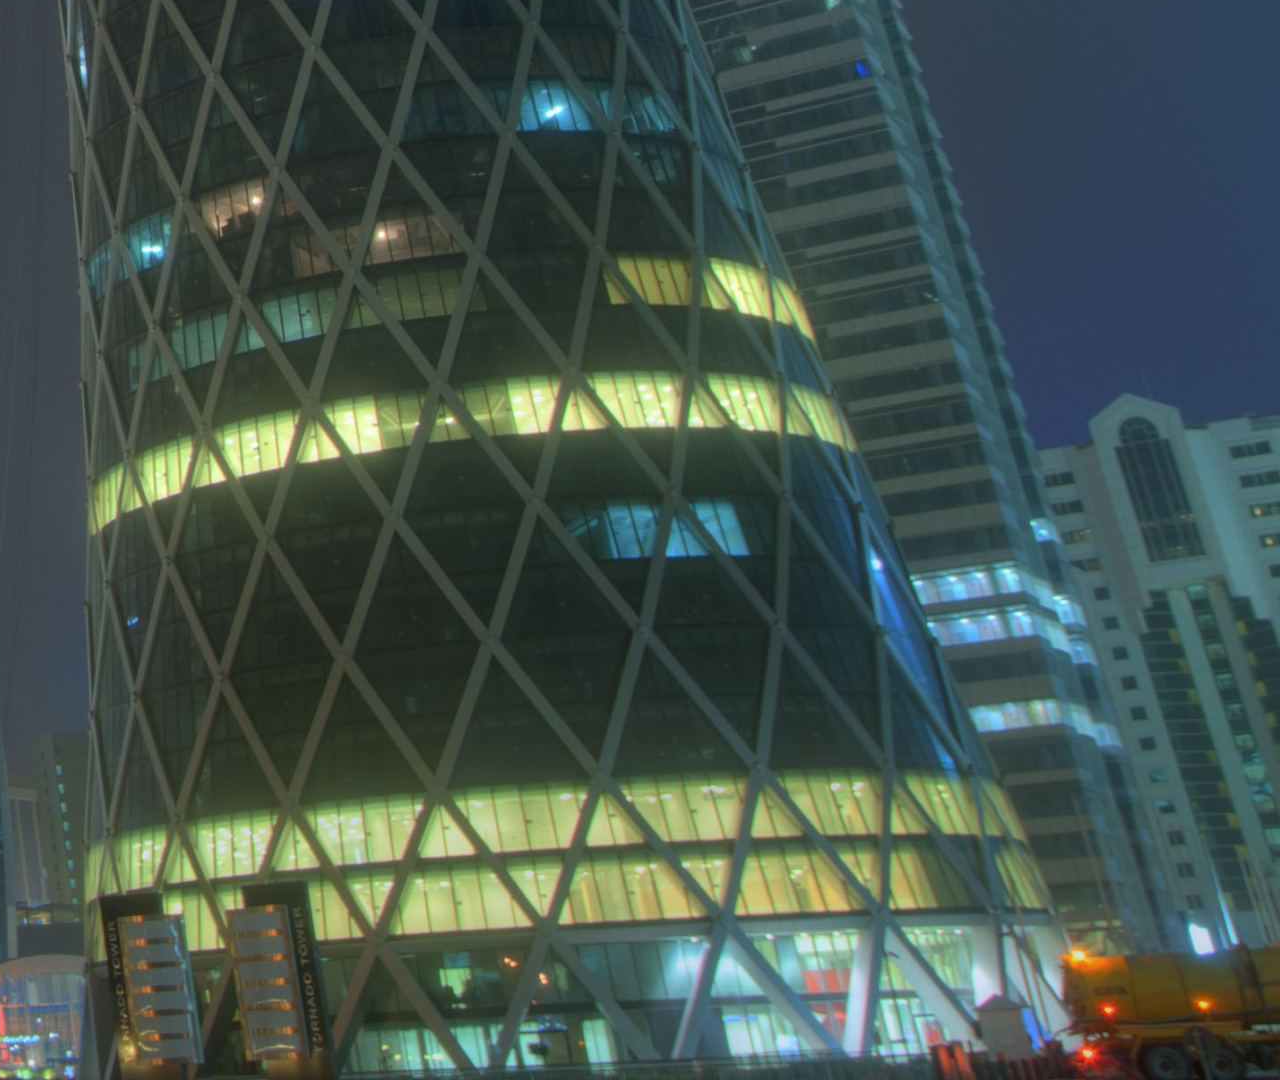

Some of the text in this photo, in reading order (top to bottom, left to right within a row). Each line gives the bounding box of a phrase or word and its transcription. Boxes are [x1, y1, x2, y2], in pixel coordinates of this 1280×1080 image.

[107, 921, 122, 979] TOWER
[292, 906, 324, 1054] TORNADO TOWER
